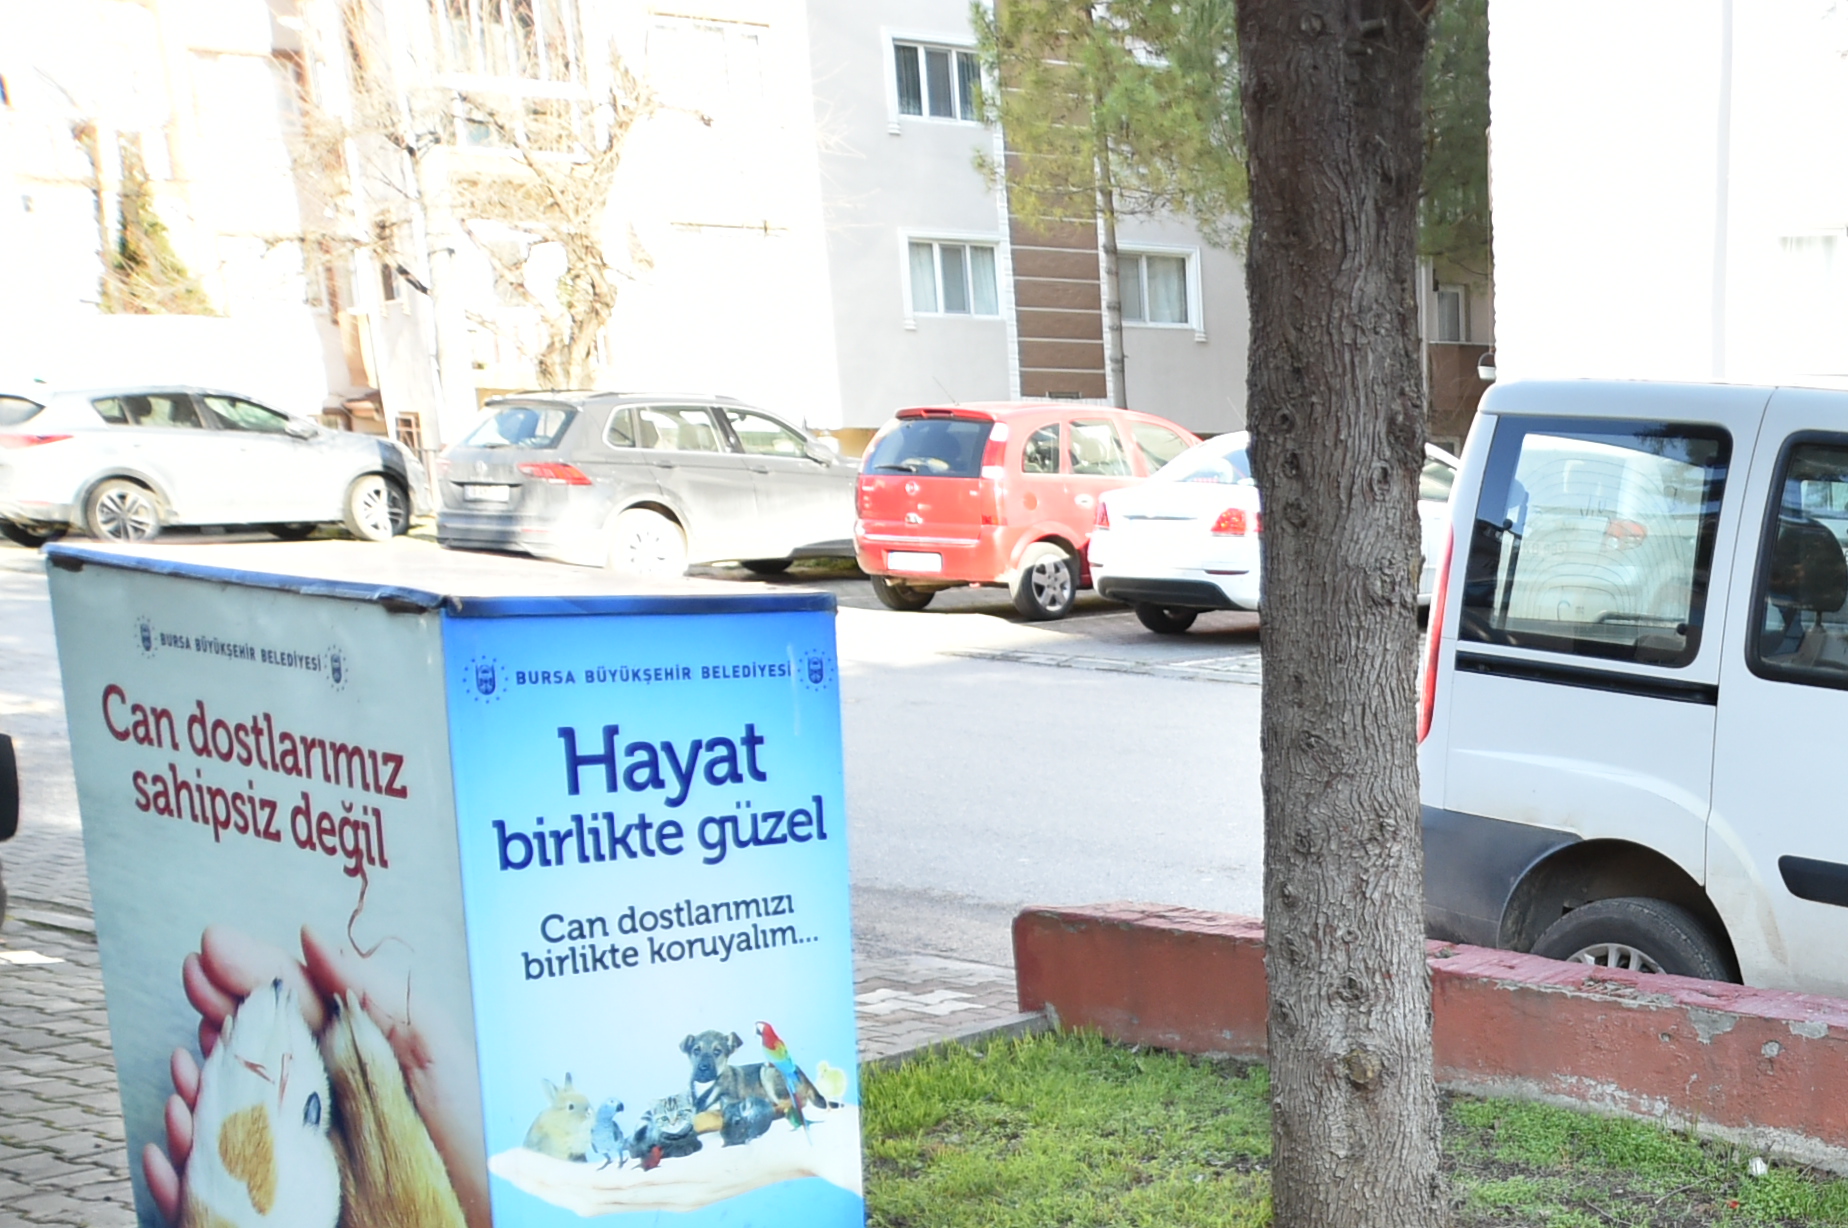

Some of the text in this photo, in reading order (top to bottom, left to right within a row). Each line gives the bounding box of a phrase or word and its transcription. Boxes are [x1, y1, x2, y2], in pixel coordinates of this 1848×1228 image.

[160, 632, 322, 672] BURSA BÜYÜKŞEHİR BELEDİYESİ
[516, 661, 791, 685] BURSA BÜYÜKŞEHİR BELEDİYESİ
[102, 683, 408, 799] Can dostlarımız
[557, 723, 767, 807] Hayat
[132, 763, 389, 878] sahipsiz değil
[492, 795, 828, 871] birlikte güzel
[540, 894, 795, 943] Can dostlarımızı
[521, 924, 819, 980] birlikte koruyalım...
